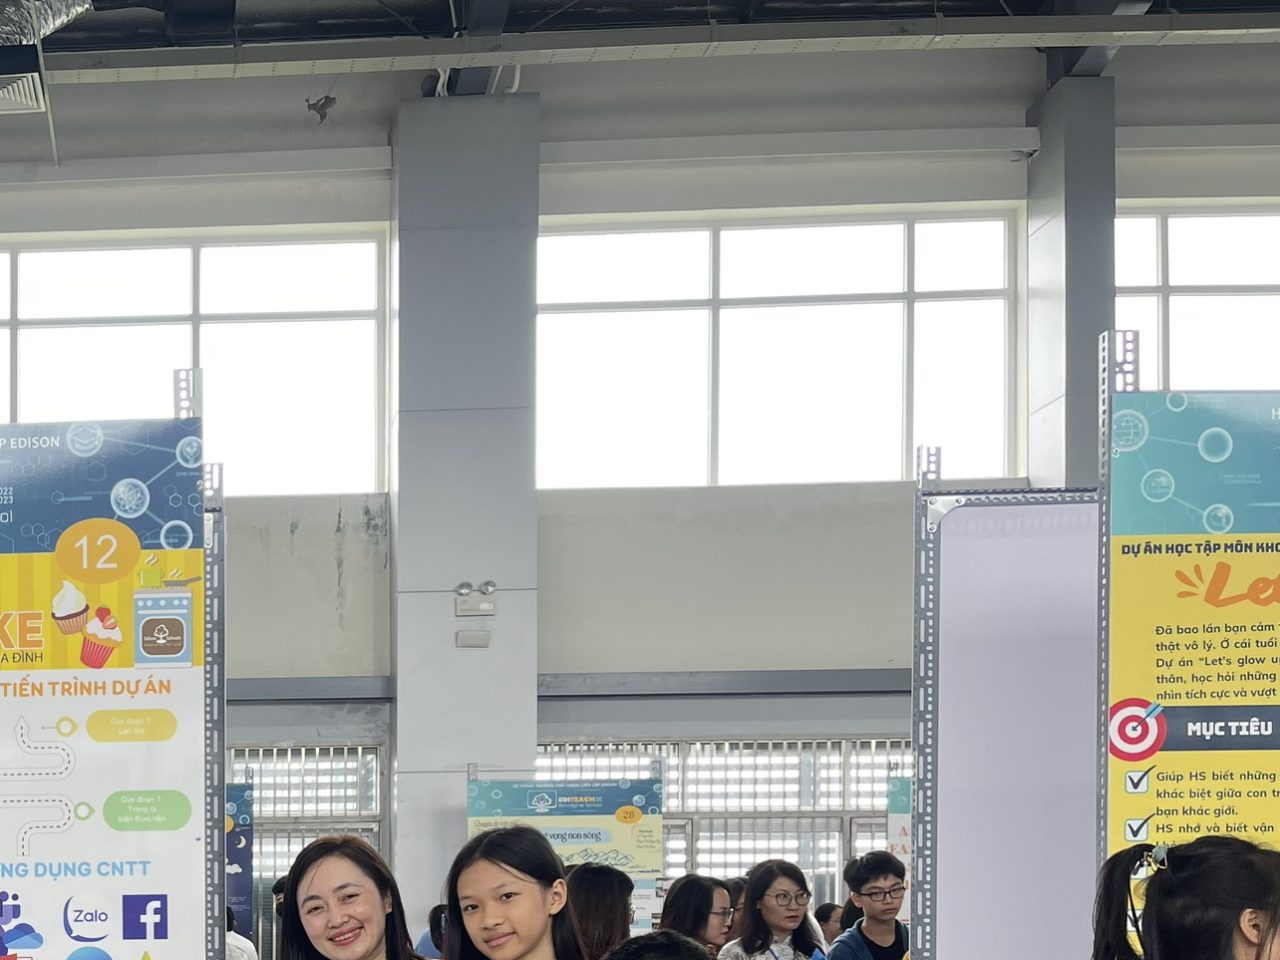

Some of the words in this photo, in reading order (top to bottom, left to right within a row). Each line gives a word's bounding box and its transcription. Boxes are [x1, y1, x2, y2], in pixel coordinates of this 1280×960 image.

[10, 436, 60, 448] EDISON
[75, 534, 118, 569] 12
[1122, 543, 1141, 557] DỰ
[1144, 541, 1162, 554] ÁN
[1165, 543, 1192, 557] HỌC
[1195, 540, 1221, 556] TẬP
[1224, 540, 1253, 553] MÔN
[1204, 561, 1280, 607] Le
[1155, 625, 1172, 635] Đã
[1177, 625, 1198, 634] bao
[1203, 623, 1220, 634] lần
[1224, 623, 1246, 635] bạn
[1251, 622, 1275, 632] cảm
[1156, 640, 1180, 651] thật
[1185, 641, 1198, 650] vô
[1203, 640, 1216, 652] lý.
[1221, 638, 1230, 649] Ở
[1234, 639, 1251, 648] cái
[1256, 637, 1277, 648] tuổi
[12, 650, 43, 663] ĐÌNH
[1156, 658, 1173, 668] Dự
[1179, 657, 1193, 667] án
[1238, 655, 1266, 667] glow
[1272, 655, 1280, 663] u
[1156, 674, 1186, 684] thân,
[1192, 673, 1212, 684] học
[1217, 671, 1235, 682] hỏi
[1240, 671, 1277, 683] những
[0, 674, 45, 698] TIẾN
[49, 676, 107, 696] TRÌNH
[112, 678, 140, 698] DỰ
[144, 674, 171, 695] ÁN
[1157, 690, 1181, 700] nhìn
[1185, 688, 1207, 699] tích
[1210, 689, 1230, 700] cực
[1234, 689, 1247, 697] và
[1251, 688, 1276, 700] vượt
[1187, 721, 1225, 740] MỤC
[1228, 717, 1273, 736] TIÊU
[1156, 771, 1184, 783] Giúp
[1189, 771, 1206, 781] HS
[1212, 771, 1234, 781] biết
[1239, 770, 1276, 782] những
[1156, 789, 1184, 799] khác
[1189, 789, 1212, 800] biệt
[1216, 789, 1241, 800] giữa
[1247, 790, 1267, 798] con
[623, 811, 635, 819] 28
[1156, 807, 1178, 817] bạn
[1182, 806, 1210, 816] khác
[1214, 806, 1238, 818] giới.
[34, 862, 92, 880] DỤNG
[97, 860, 151, 876] CNTT
[73, 909, 108, 923] Zalo
